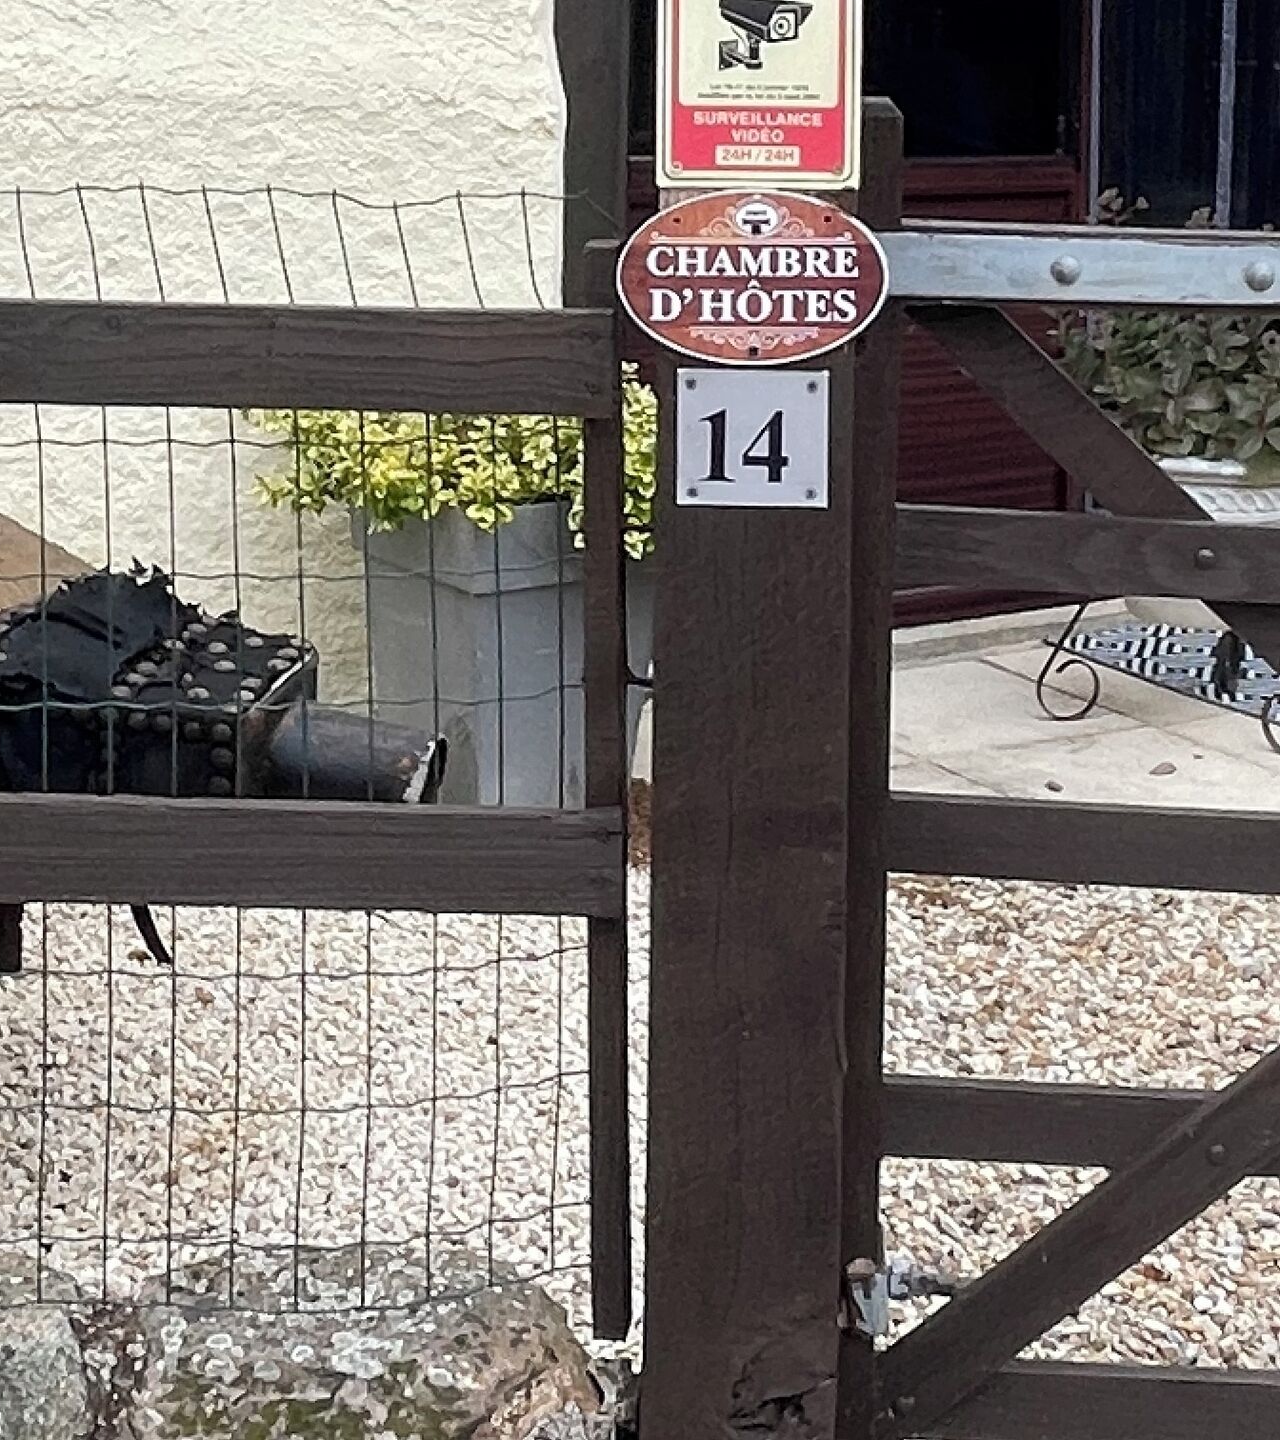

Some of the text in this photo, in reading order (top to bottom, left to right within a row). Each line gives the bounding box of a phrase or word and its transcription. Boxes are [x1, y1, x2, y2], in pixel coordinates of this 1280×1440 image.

[693, 111, 823, 127] SURVEILLANCE
[730, 127, 784, 143] VIDÉO
[722, 148, 752, 161] 24H
[764, 148, 795, 162] 24H
[646, 245, 859, 278] CHAMBRE
[648, 279, 858, 323] D'HÔTES
[698, 409, 789, 483] 14
